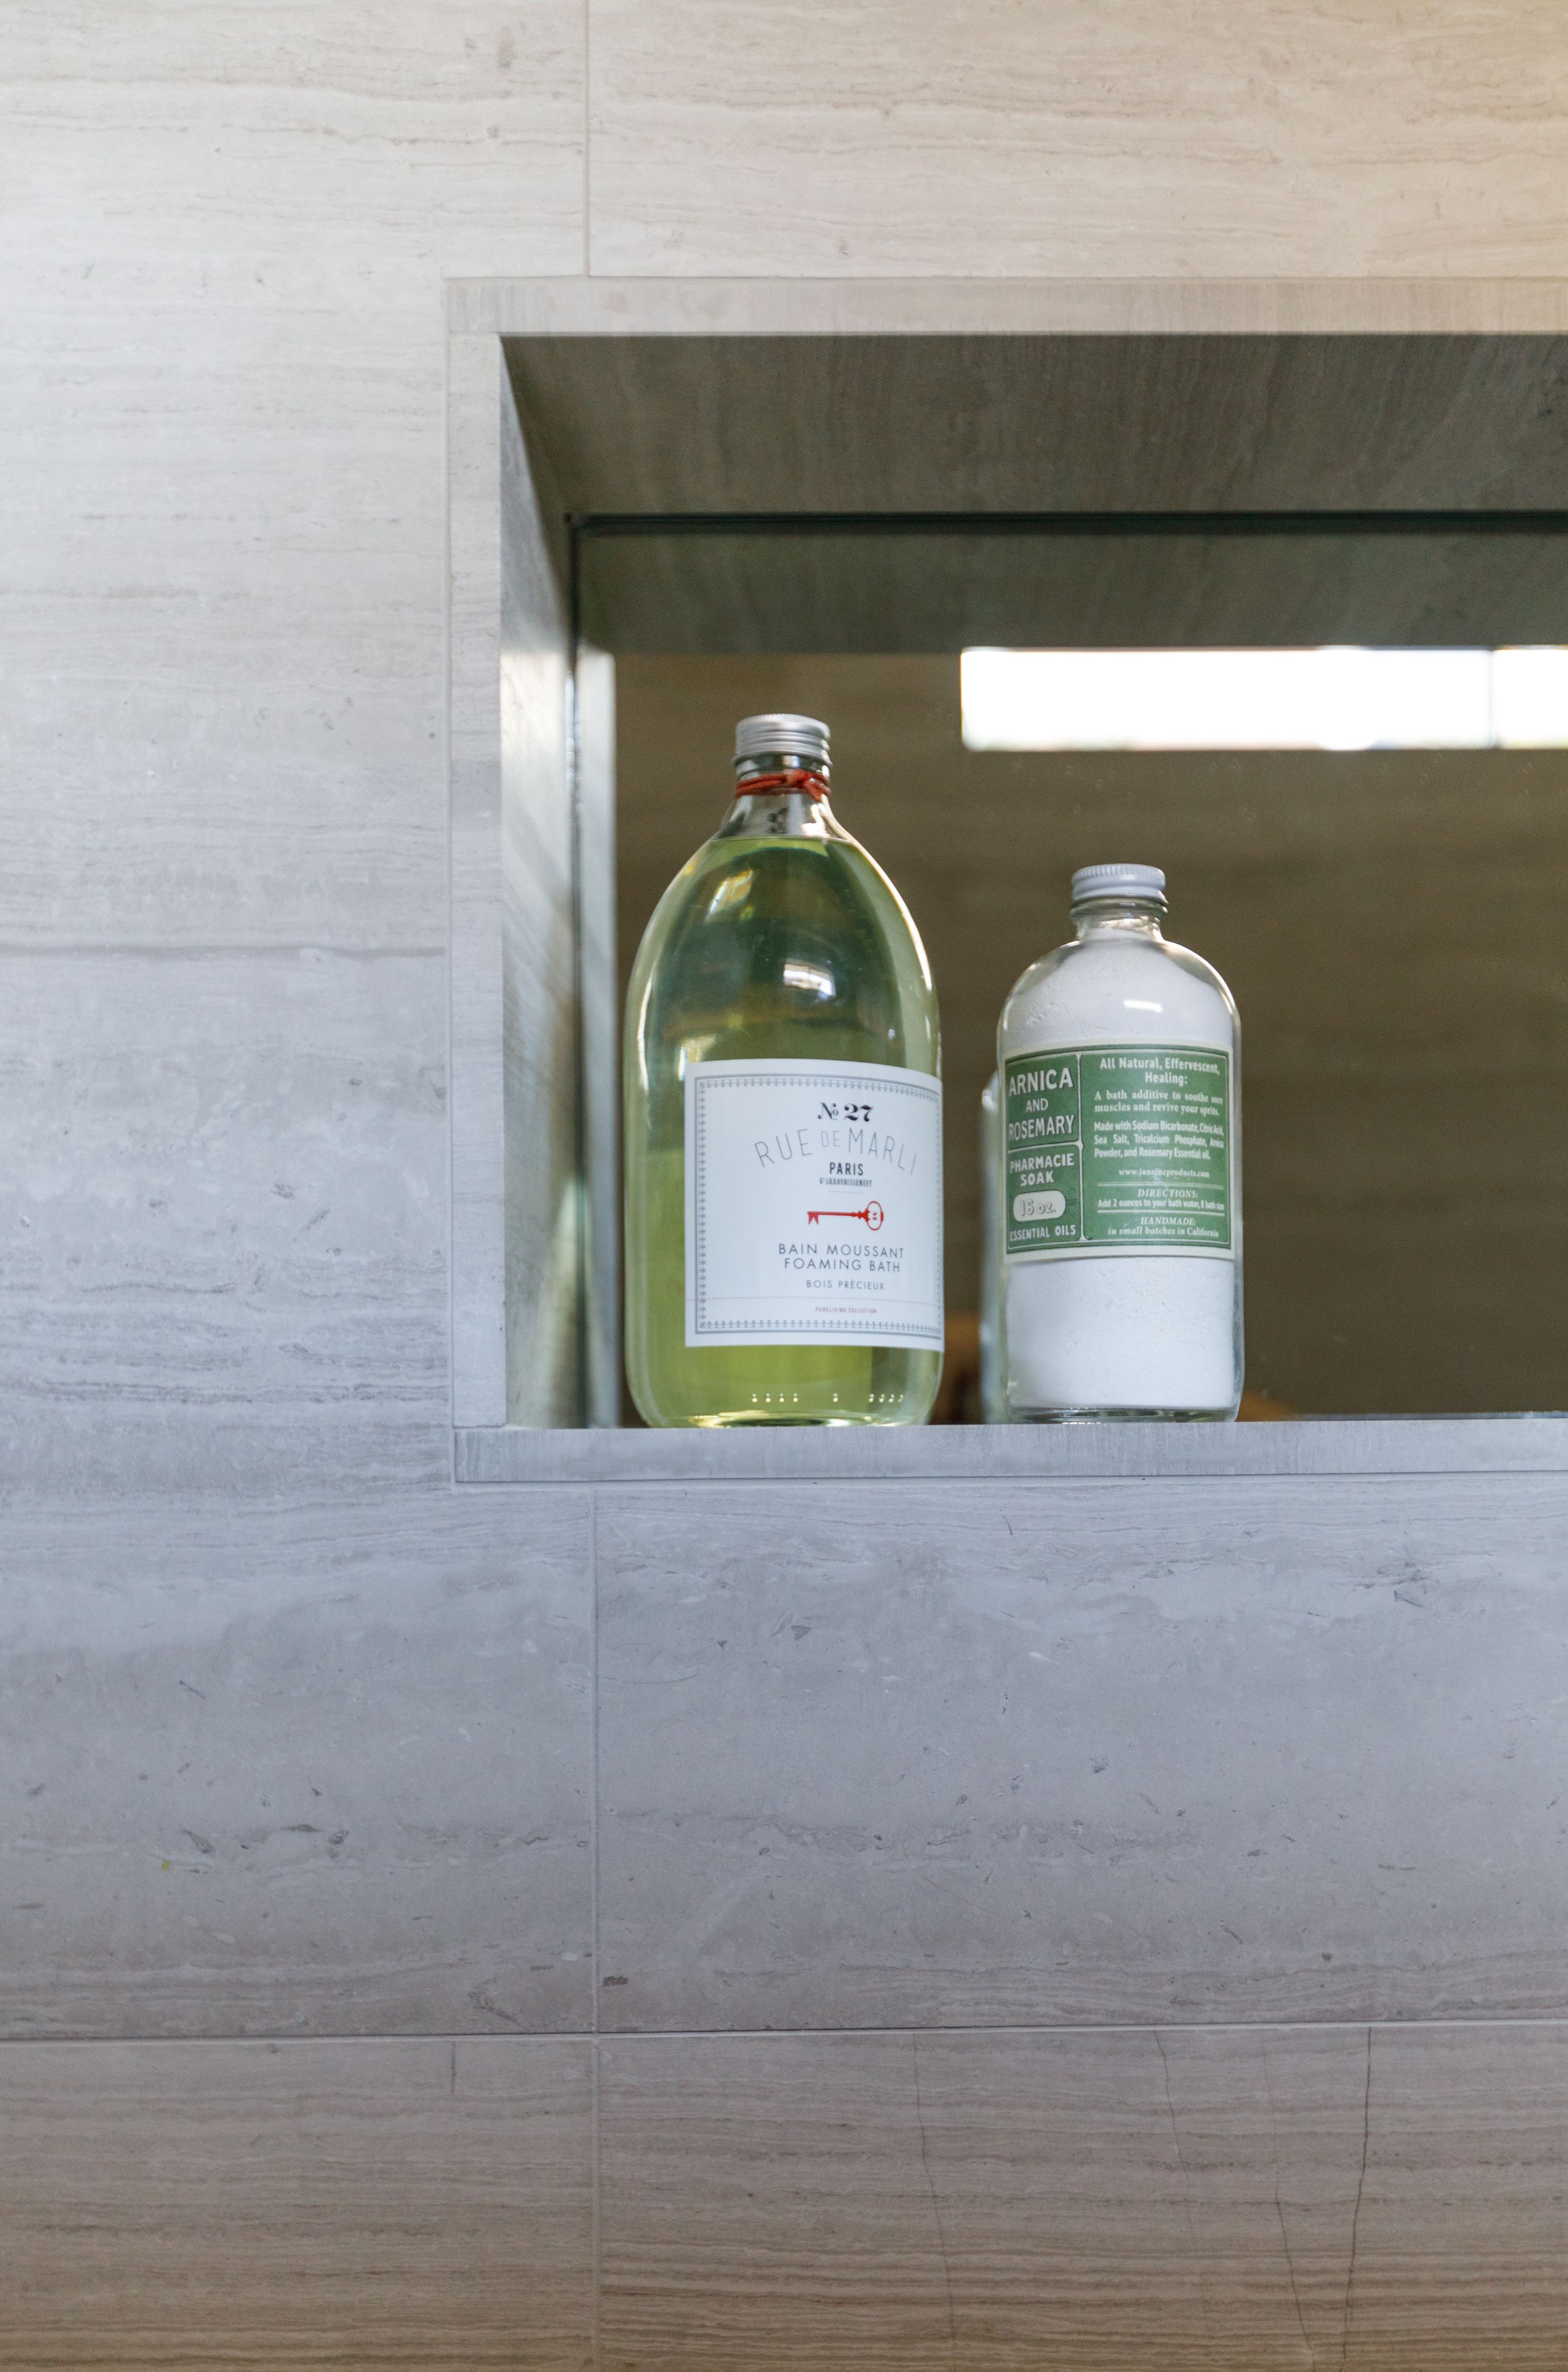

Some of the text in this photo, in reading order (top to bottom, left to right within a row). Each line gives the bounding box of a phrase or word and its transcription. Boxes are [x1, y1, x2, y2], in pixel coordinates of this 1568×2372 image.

[1100, 1057, 1220, 1075] All Natural, Effervescent,
[1009, 1067, 1074, 1097] ARNICA
[1145, 1072, 1188, 1087] Healing:
[1094, 1089, 1223, 1104] A bath additive to soothe sore
[844, 1103, 874, 1122] 27
[1025, 1098, 1049, 1113] AND
[1094, 1102, 1131, 1112] muscles
[1133, 1101, 1151, 1111] and
[1153, 1102, 1179, 1112] revive
[1181, 1104, 1199, 1114] your
[1009, 1115, 1074, 1141] ROSEMARY
[1094, 1121, 1114, 1131] Made
[1115, 1121, 1131, 1130] with
[1132, 1120, 1159, 1130] Sodium
[1160, 1121, 1200, 1133] Bicarbonate,
[1200, 1123, 1212, 1133] Citric
[1094, 1135, 1107, 1144] Sea
[1113, 1134, 1130, 1145] Salt,
[1134, 1134, 1170, 1144] Tricalcium
[1174, 1134, 1207, 1147] Phosphate,
[754, 1127, 917, 1175] RUE DE MARLI
[1094, 1147, 1211, 1160] Powder, and Rosemary Essential oil.
[829, 1162, 864, 1176] PARIS
[1010, 1153, 1074, 1173] PHARMACIE
[1020, 1171, 1054, 1186] SOAK
[1138, 1189, 1199, 1198] DIRECTIONS:
[1020, 1199, 1056, 1216] 16 oz.
[1098, 1199, 1111, 1208] Add
[1113, 1199, 1117, 1207] 2
[1152, 1200, 1167, 1208] your
[1168, 1199, 1182, 1208] bath
[1183, 1200, 1200, 1210] water,
[1140, 1217, 1197, 1226] HANDMADE:
[1010, 1225, 1076, 1242] ESSENTIAL OILS
[1119, 1226, 1142, 1235] small
[1145, 1226, 1175, 1235] batches
[1177, 1227, 1185, 1235] in
[1187, 1227, 1219, 1237] California
[778, 1243, 904, 1259] BAIN MOUSSANT
[785, 1258, 900, 1273] FOAMING BATH
[807, 1279, 884, 1290] BOIS PRÉCIEUX
